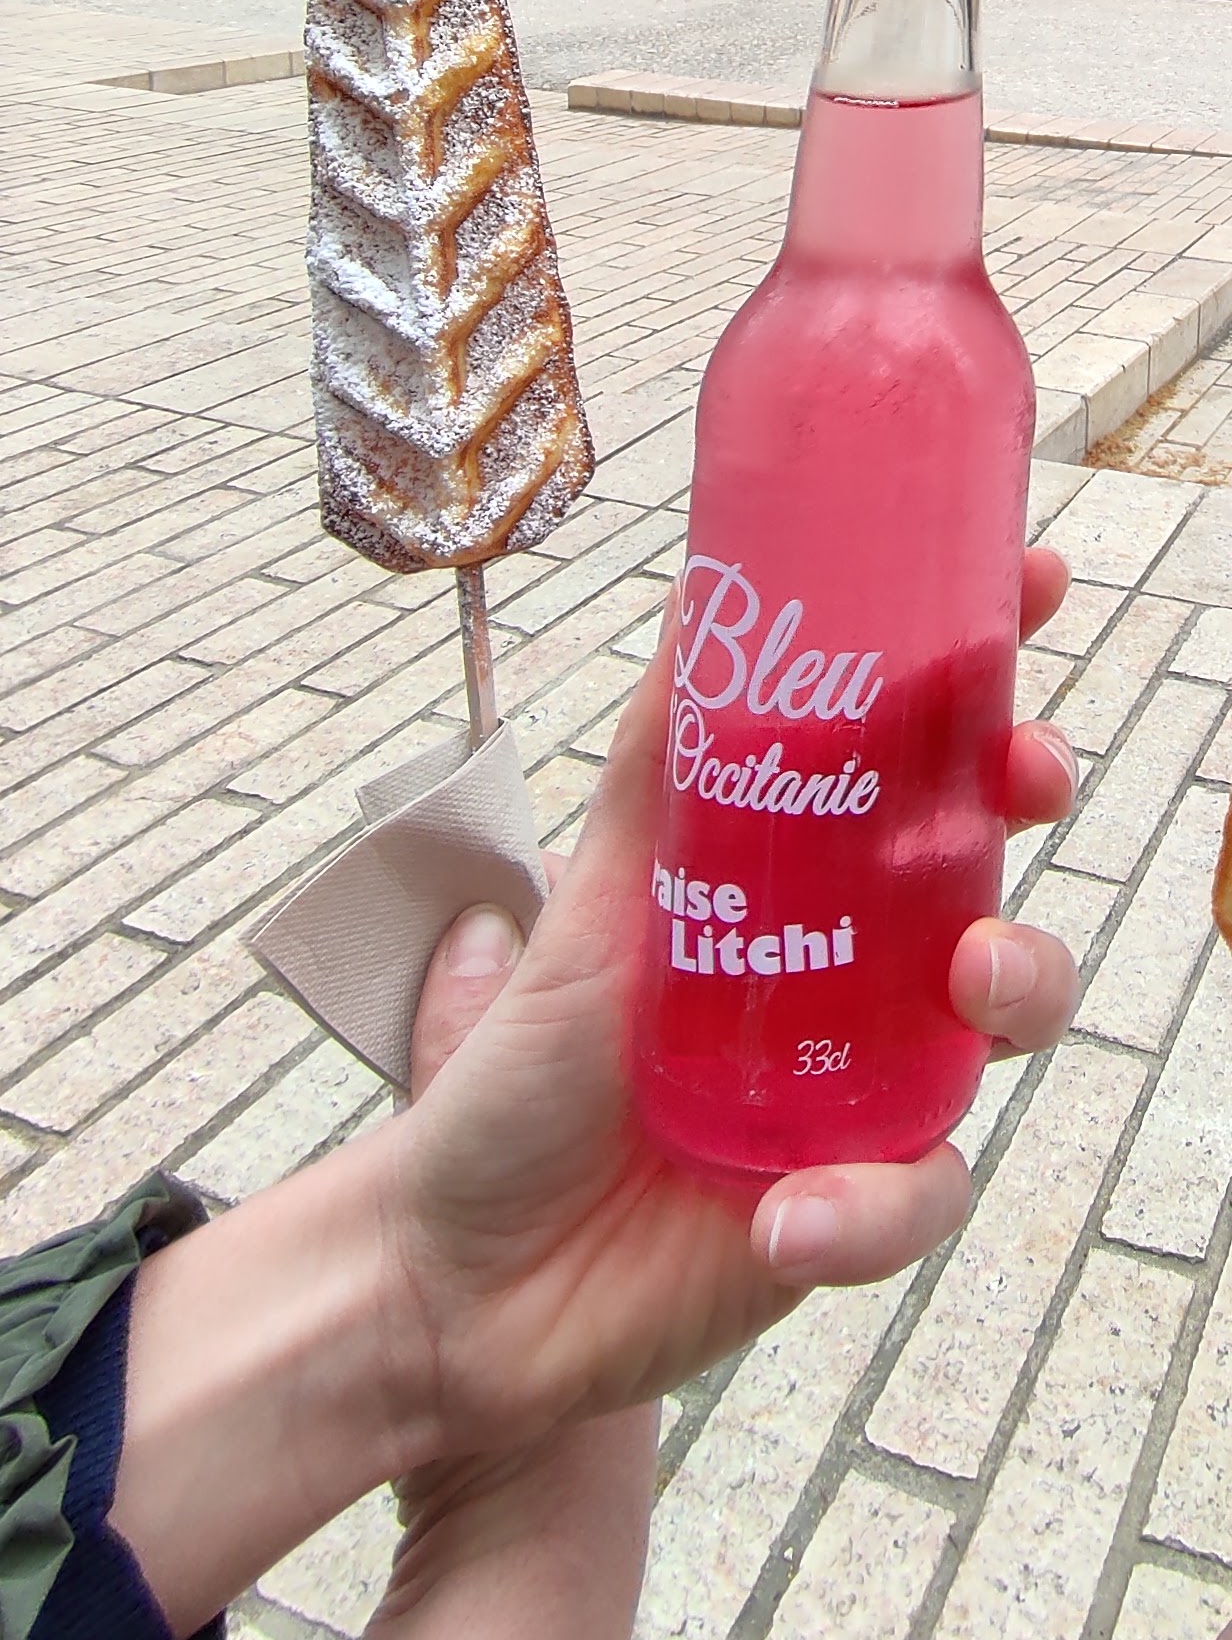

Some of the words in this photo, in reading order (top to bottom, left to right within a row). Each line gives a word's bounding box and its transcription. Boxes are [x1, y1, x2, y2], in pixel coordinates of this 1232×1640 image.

[674, 554, 884, 720] Bleu
[668, 693, 881, 816] 'Occitanie
[652, 857, 748, 923] raise
[671, 915, 855, 976] Litchi
[792, 1039, 852, 1076] 33cl
